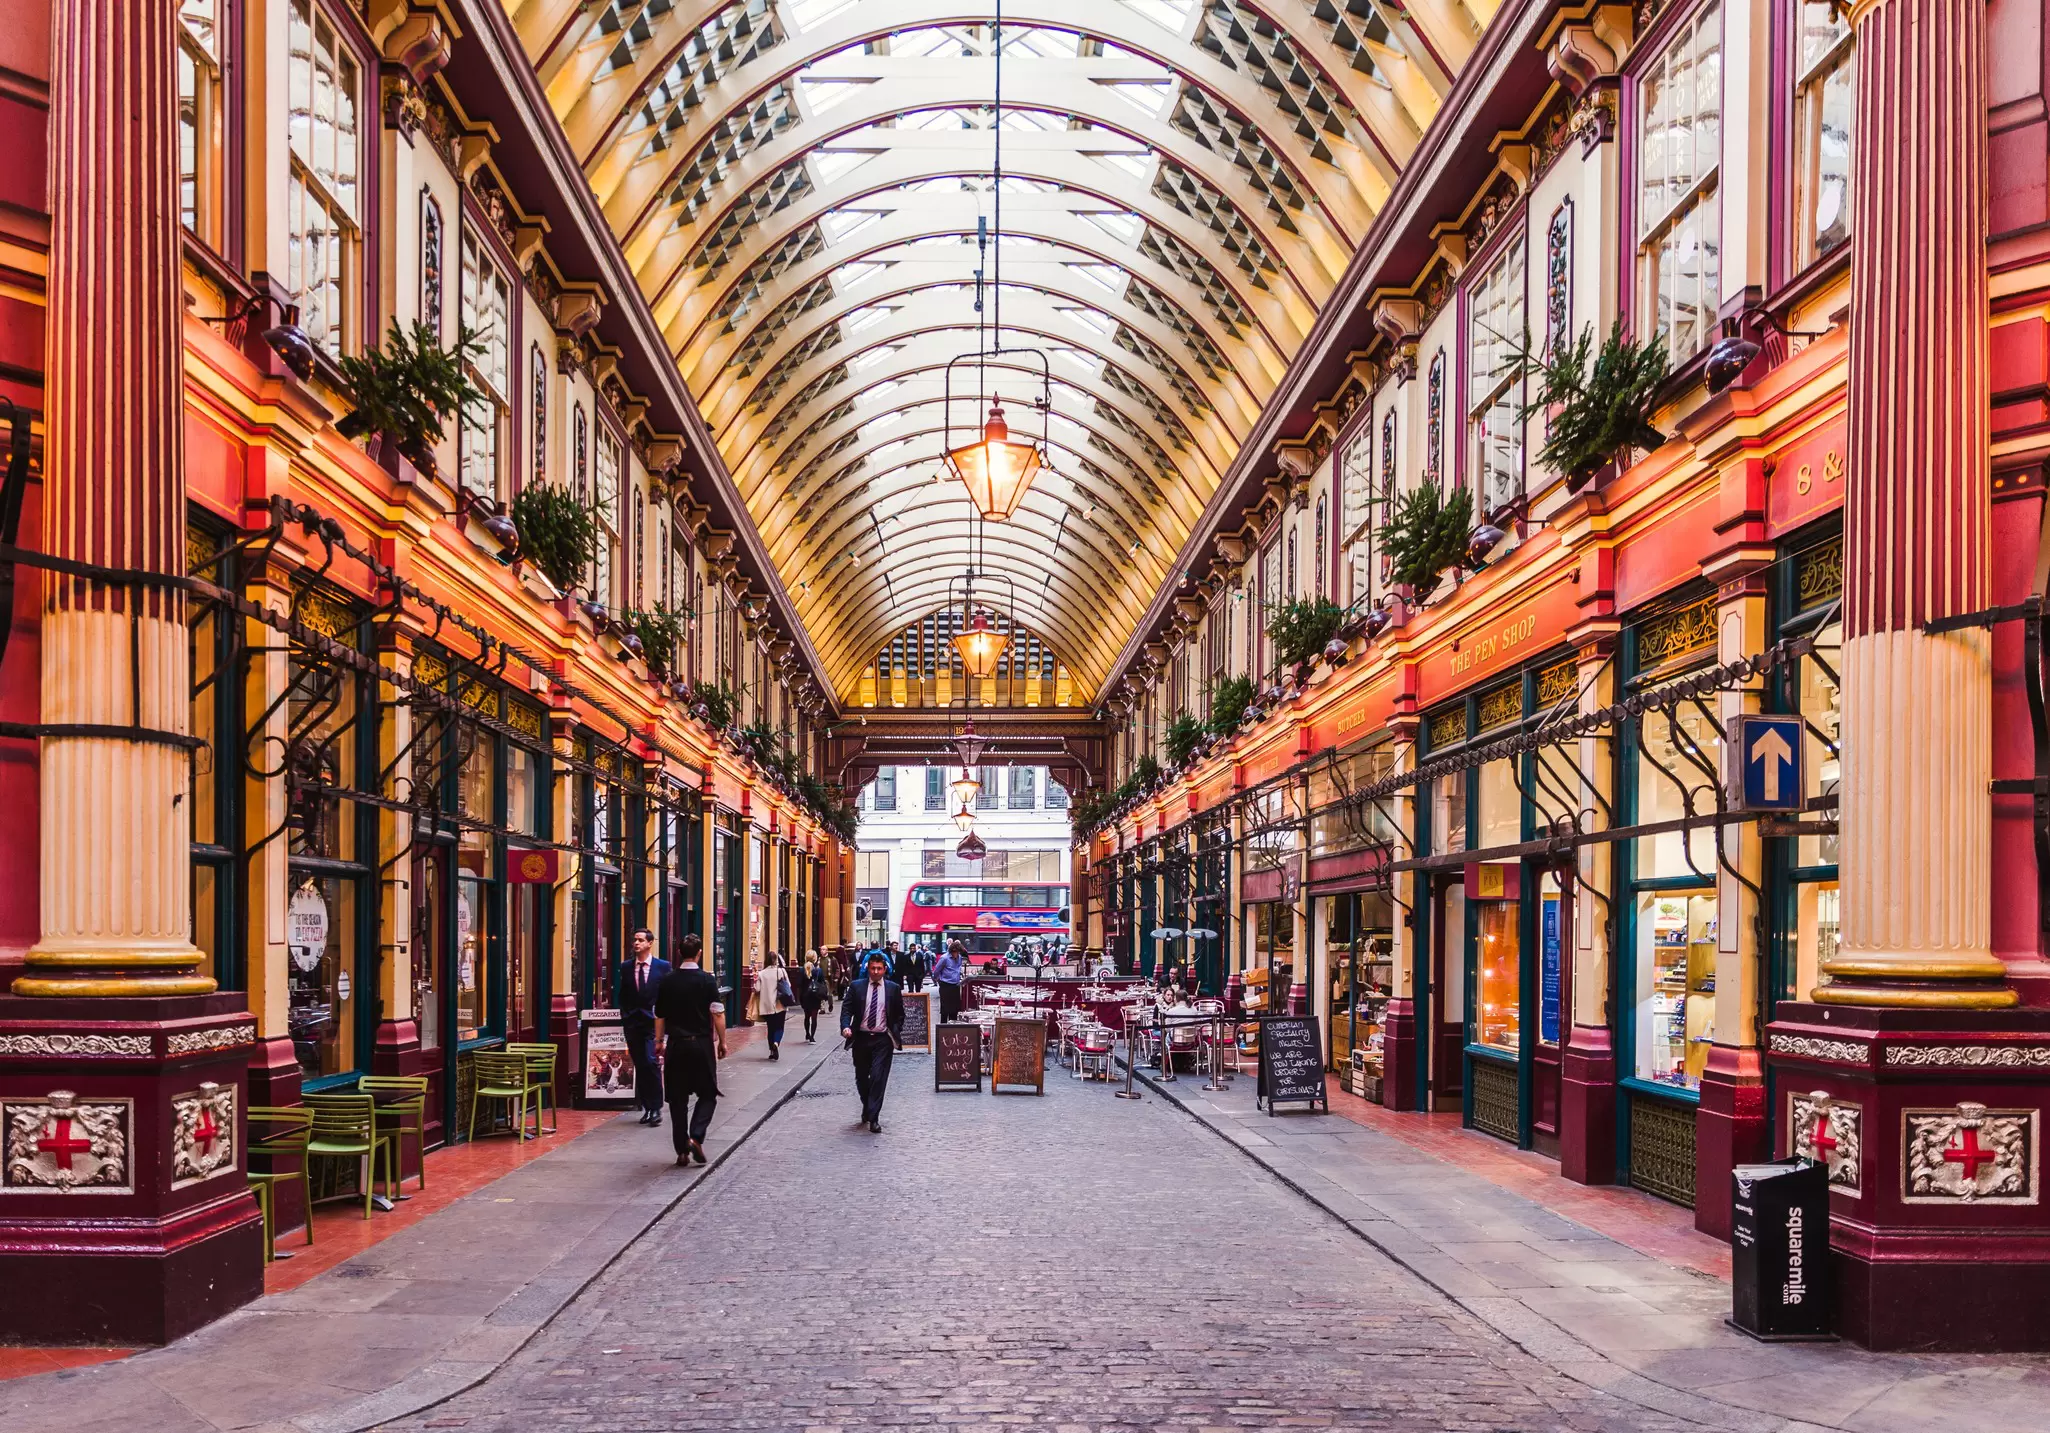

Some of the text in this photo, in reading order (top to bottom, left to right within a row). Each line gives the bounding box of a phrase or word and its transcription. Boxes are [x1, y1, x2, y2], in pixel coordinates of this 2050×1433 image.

[1797, 450, 1843, 496] 8 &
[1450, 614, 1536, 677] THE PEN SHOP
[1337, 708, 1366, 736] BUTCHER
[1785, 1207, 1806, 1304] squaremile
